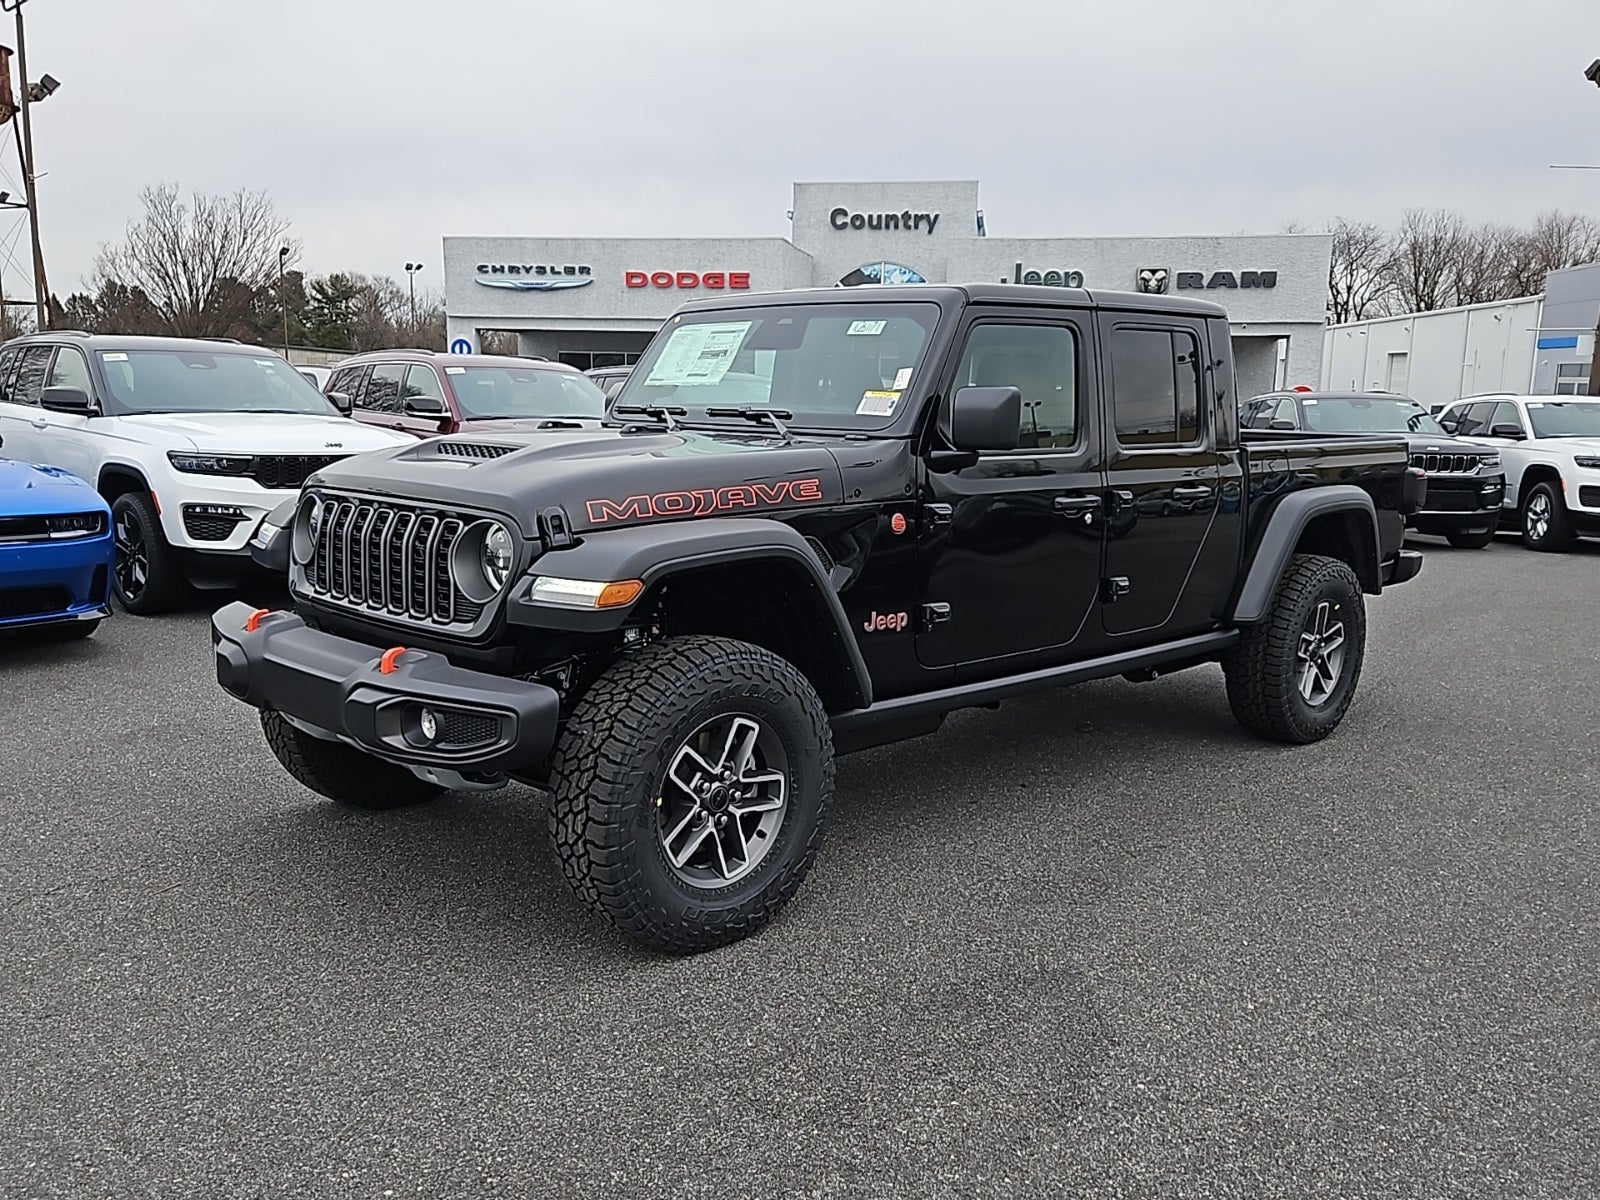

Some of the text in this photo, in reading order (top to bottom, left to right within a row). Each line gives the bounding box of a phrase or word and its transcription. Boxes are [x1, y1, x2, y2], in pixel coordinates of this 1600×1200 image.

[830, 208, 939, 235] Country
[476, 264, 592, 276] CHRYSLER
[626, 270, 750, 288] DODGE
[1000, 263, 1084, 288] Jeep
[1176, 271, 1278, 289] RAM
[586, 477, 823, 525] MOJAVE
[863, 610, 909, 634] Jeep
